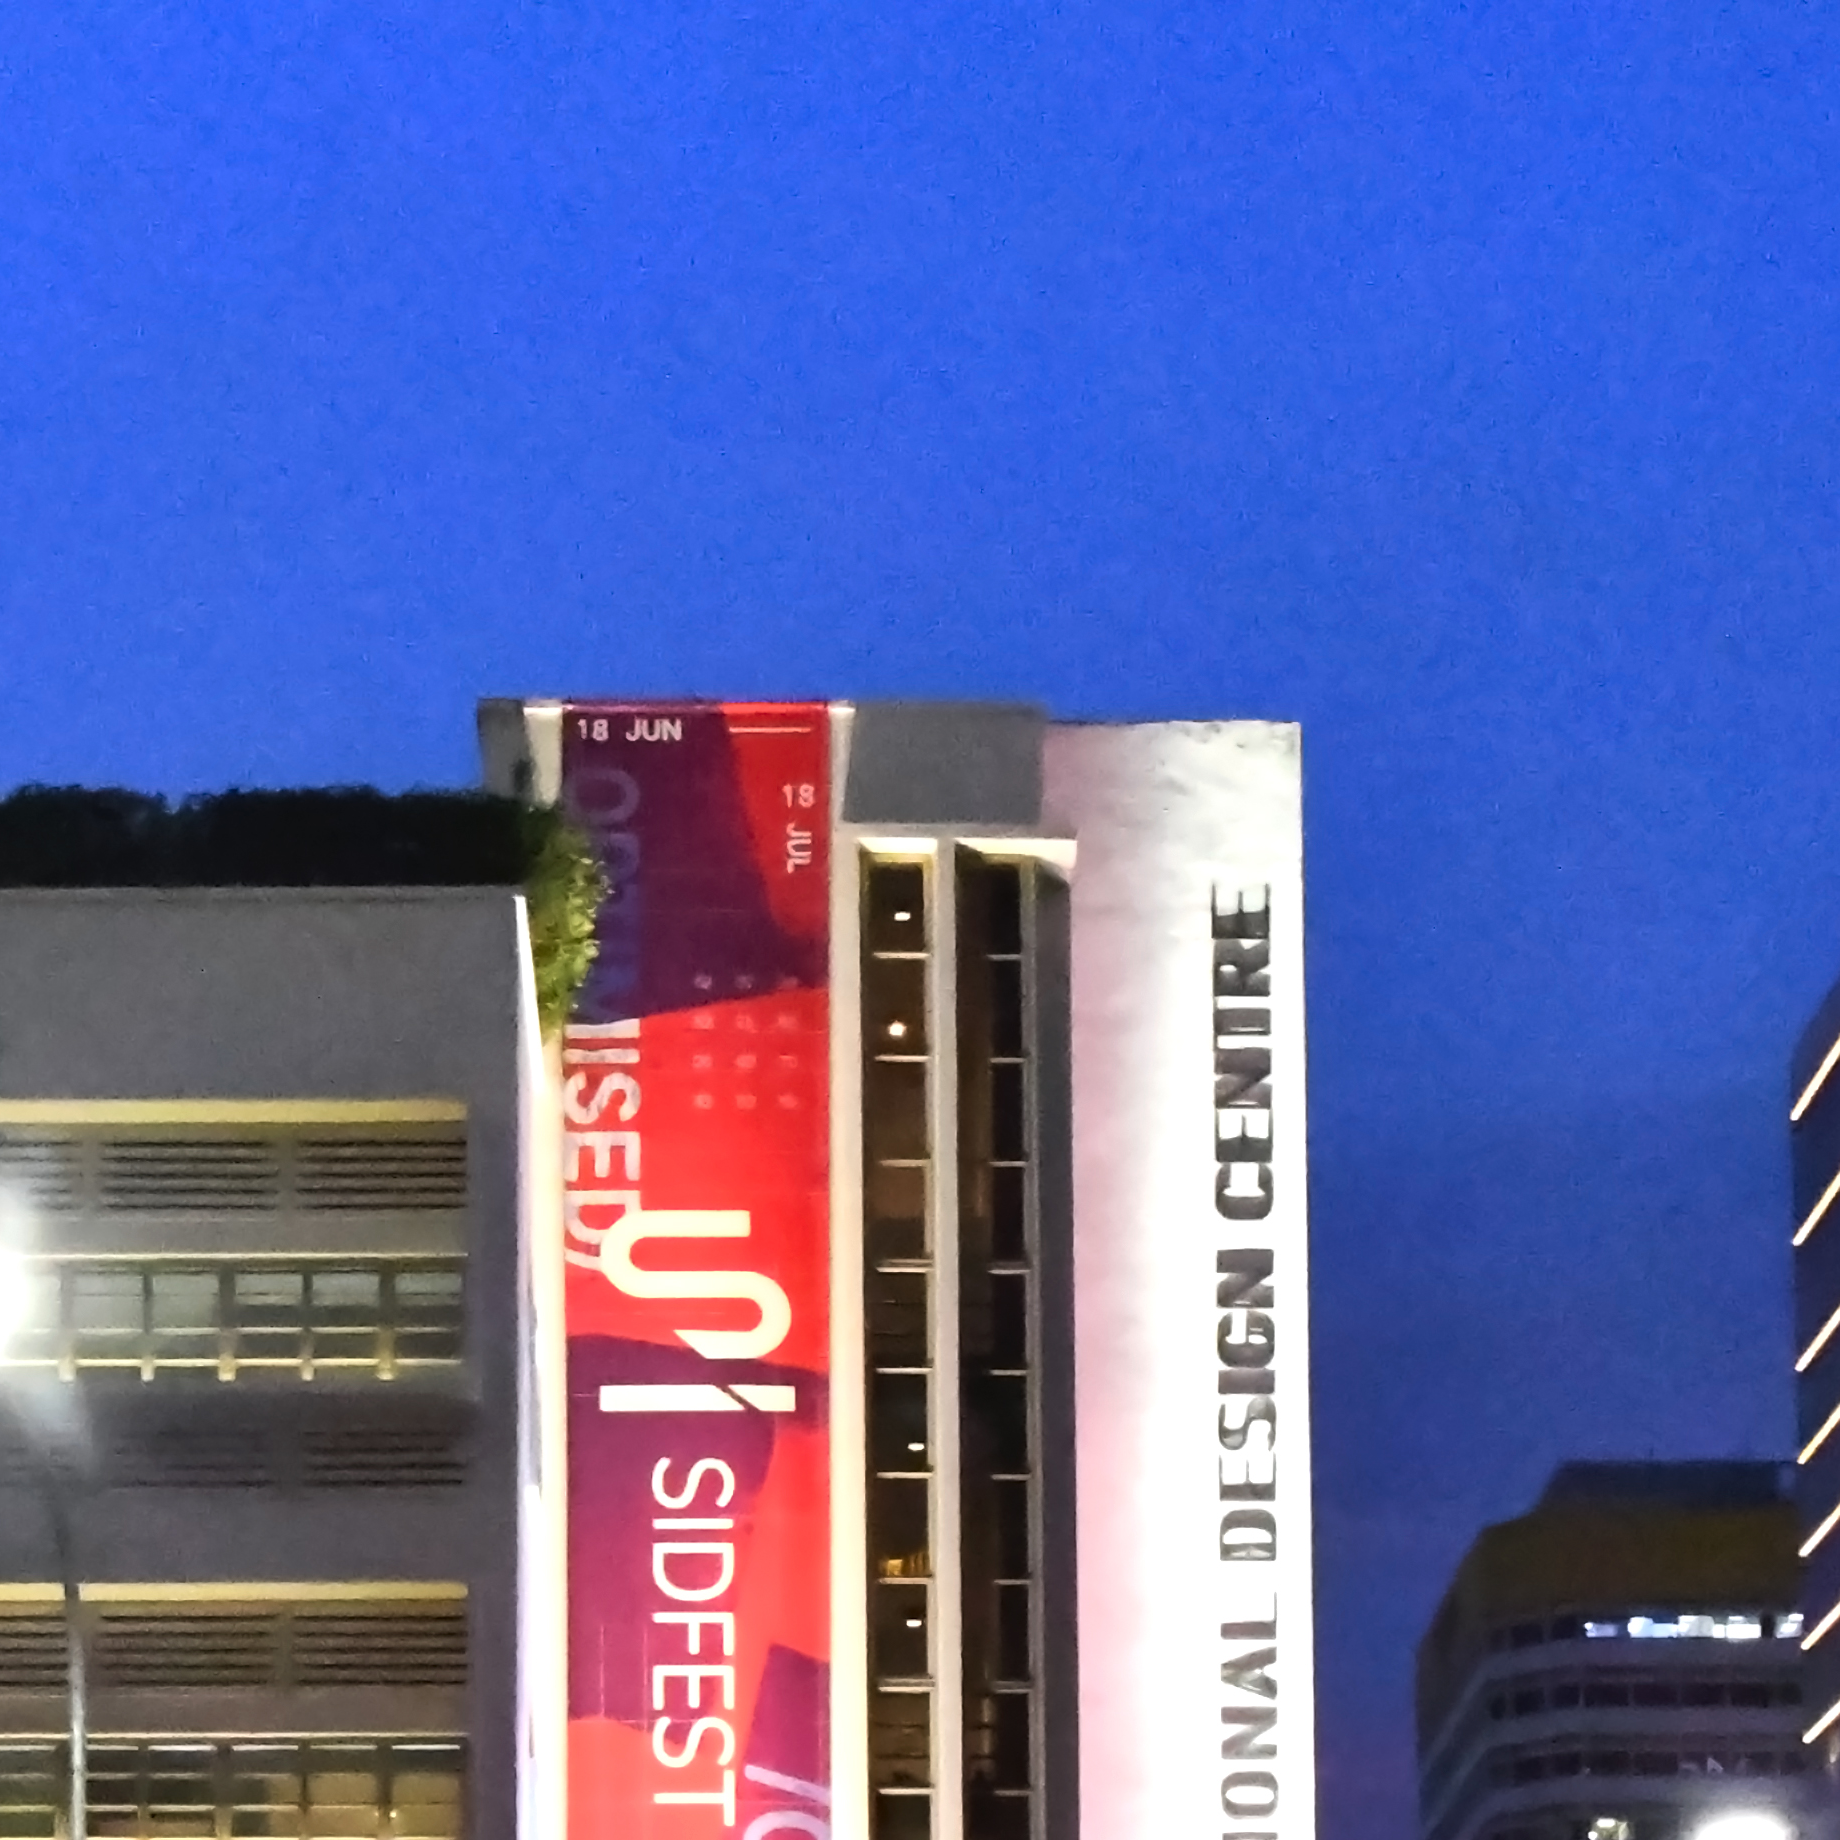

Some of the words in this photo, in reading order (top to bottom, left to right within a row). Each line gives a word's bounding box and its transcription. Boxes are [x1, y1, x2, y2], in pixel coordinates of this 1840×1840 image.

[578, 719, 609, 741] 18
[625, 717, 682, 742] JUN
[782, 783, 816, 808] 18
[786, 822, 812, 874] JUL
[1211, 882, 1275, 1221] CENTRE
[1216, 1248, 1278, 1561] DESIGN
[651, 1456, 737, 1827] SIDFEST
